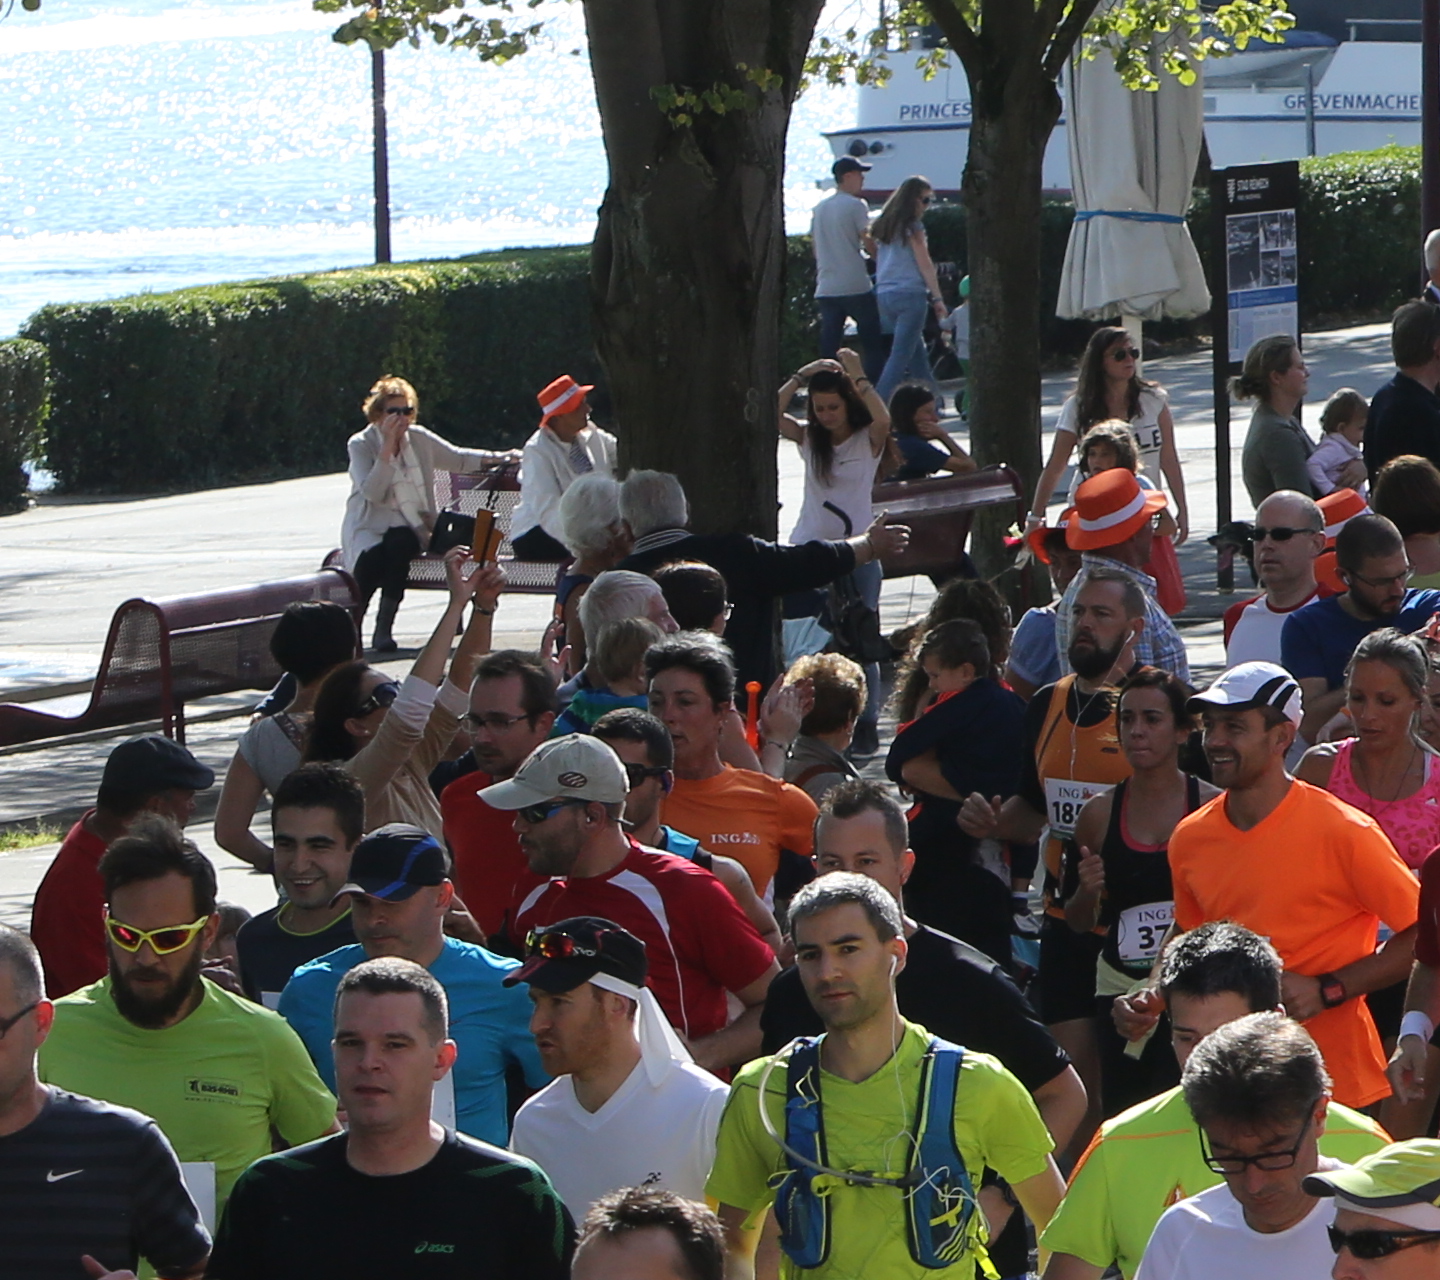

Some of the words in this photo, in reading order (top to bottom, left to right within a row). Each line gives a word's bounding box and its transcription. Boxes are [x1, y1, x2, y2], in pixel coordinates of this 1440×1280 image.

[1283, 94, 1421, 112] GREVENMACHE
[899, 102, 972, 120] PRINCES
[1058, 787, 1080, 800] ING
[711, 833, 741, 844] ING
[1138, 910, 1166, 922] ING
